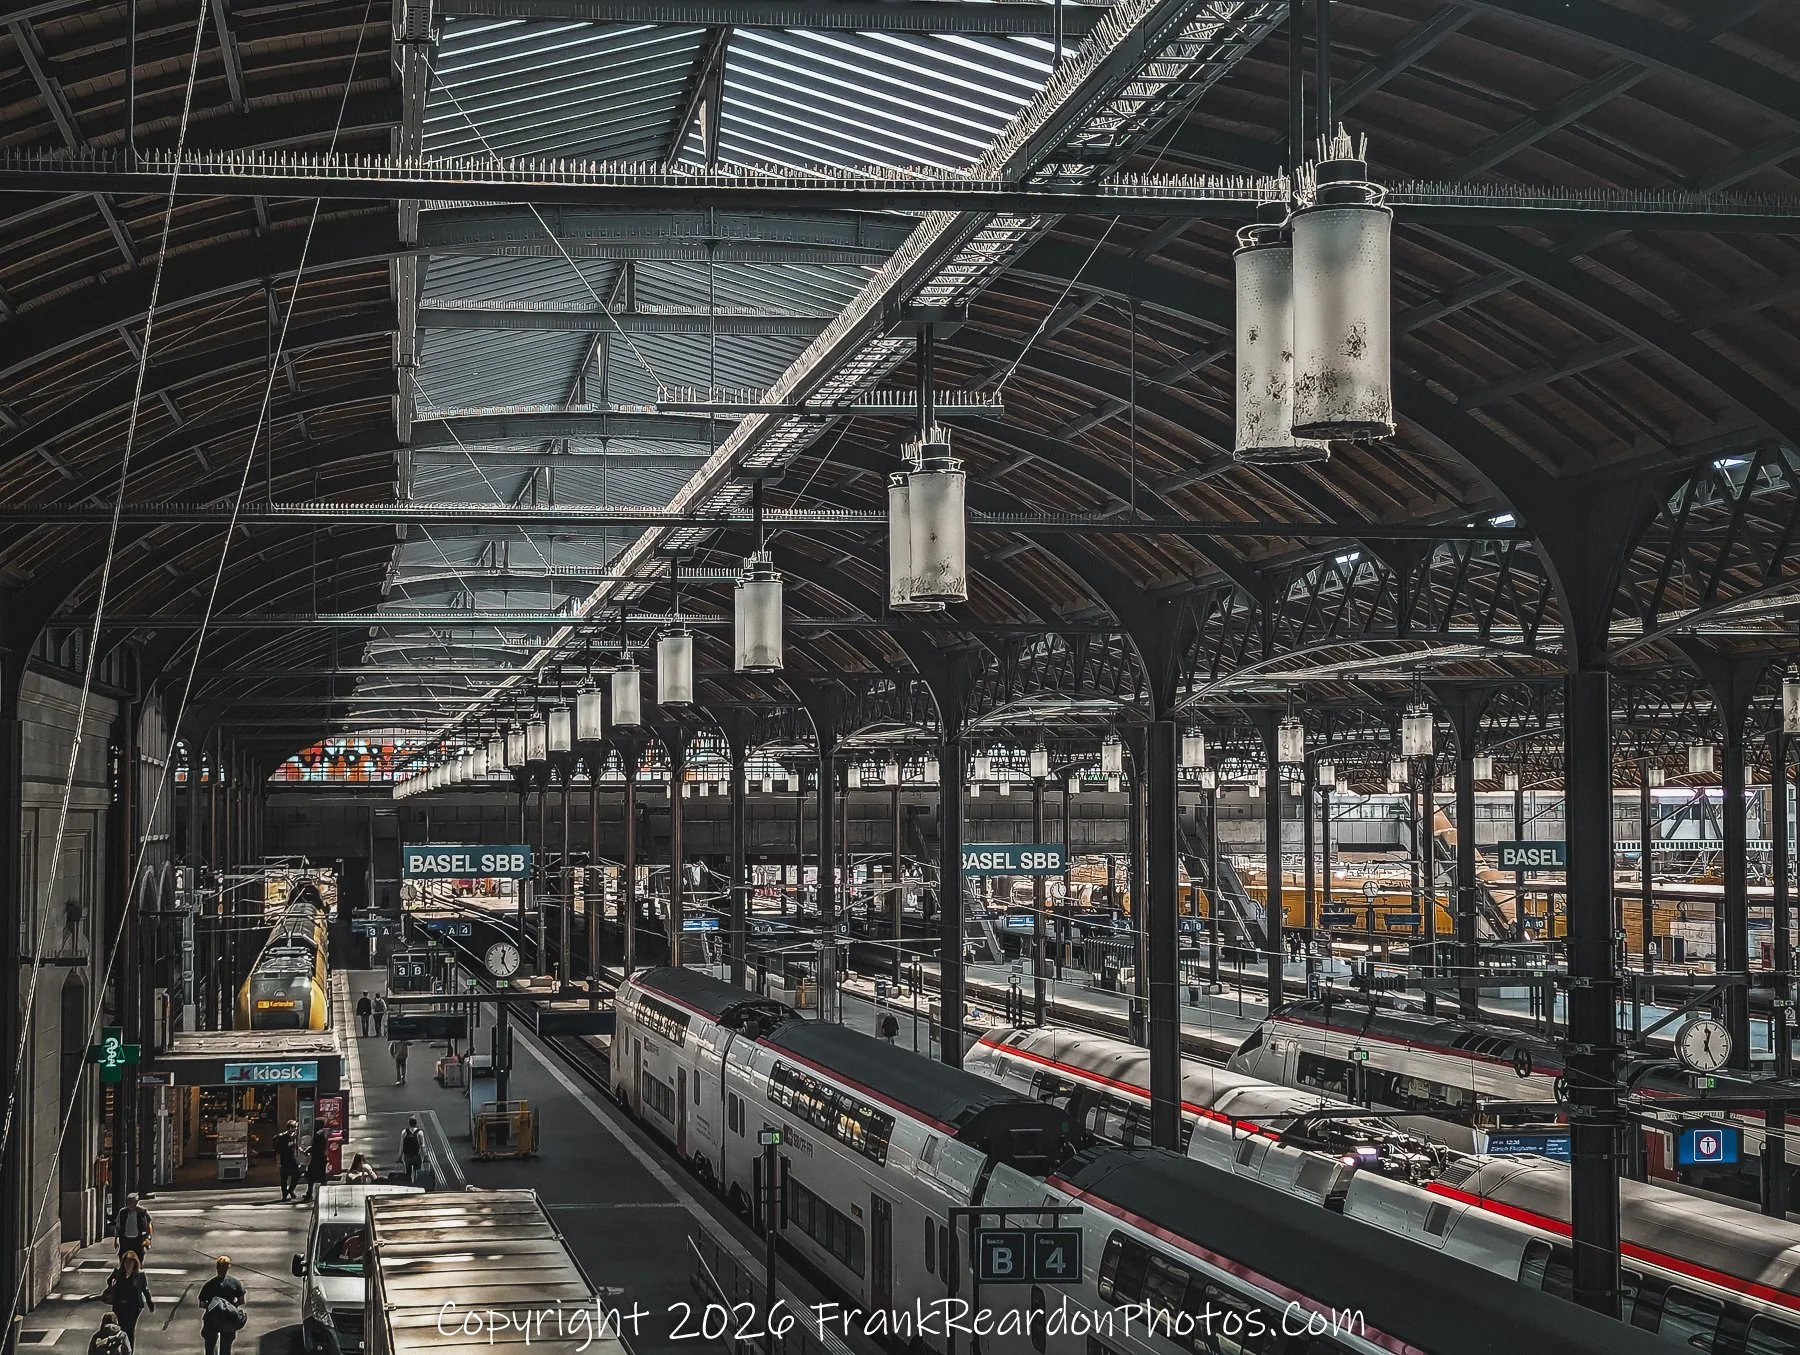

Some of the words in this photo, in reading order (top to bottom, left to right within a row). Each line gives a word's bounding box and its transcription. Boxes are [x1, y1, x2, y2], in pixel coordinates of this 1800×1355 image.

[409, 855, 477, 873] BASEL
[481, 854, 525, 872] SBB
[1020, 852, 1060, 869] SBB
[1503, 848, 1564, 866] BASEL
[369, 928, 376, 936] 3
[382, 928, 390, 936] A
[448, 927, 456, 935] A
[461, 926, 468, 934] 4
[398, 967, 406, 976] 3
[414, 967, 422, 975] B
[253, 1065, 303, 1080] kiosk
[992, 1247, 1013, 1274] B
[1045, 1247, 1067, 1274] 4
